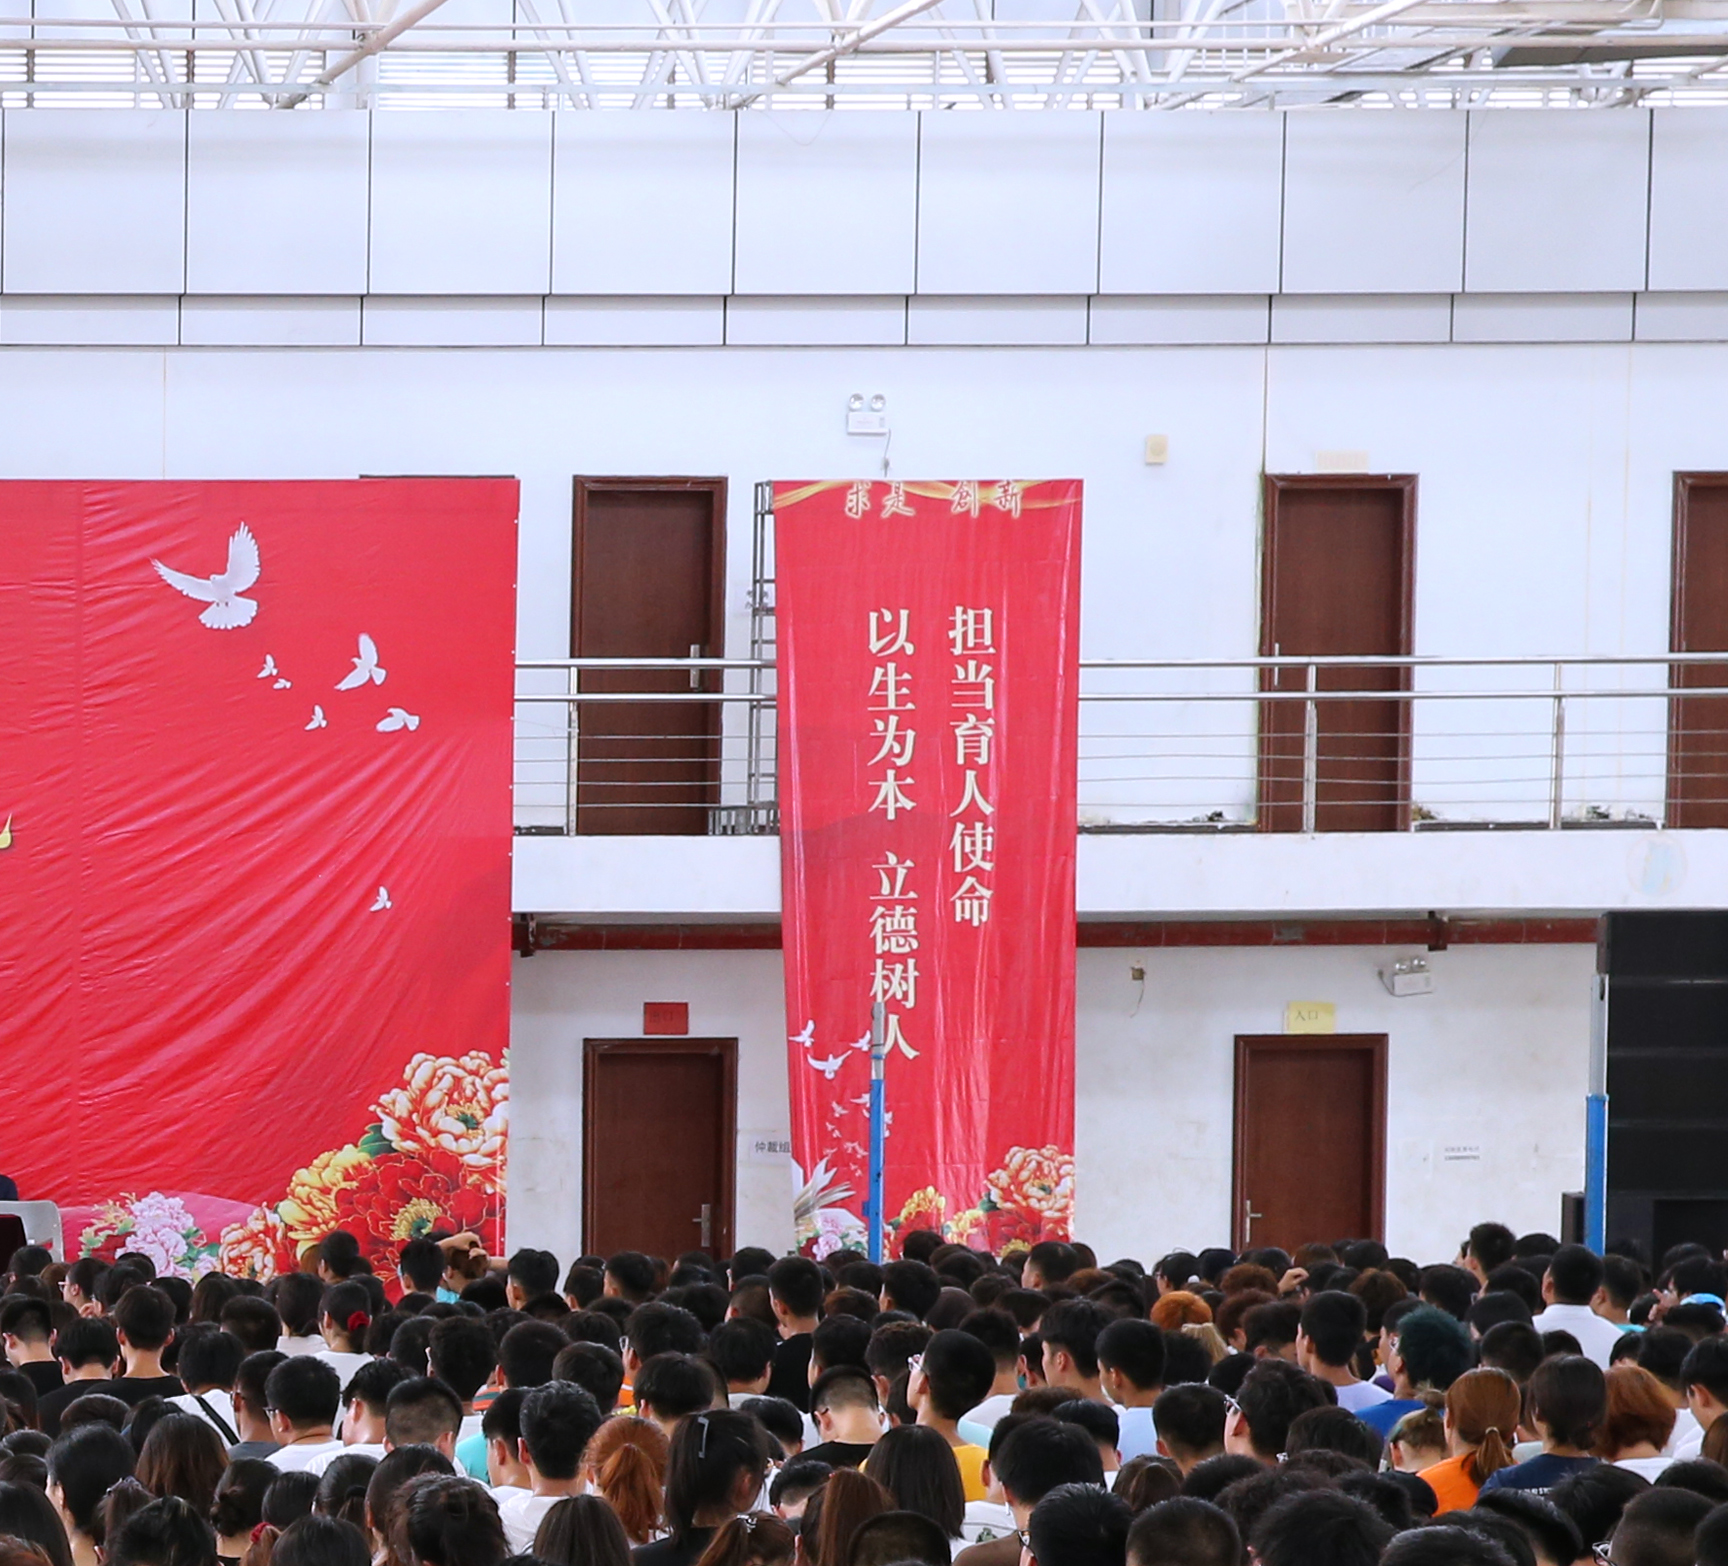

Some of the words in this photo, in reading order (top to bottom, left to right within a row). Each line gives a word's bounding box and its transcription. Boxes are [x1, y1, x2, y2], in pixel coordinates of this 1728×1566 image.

[868, 608, 918, 821] 以生为本
[947, 606, 997, 928] 担当育人使命
[869, 851, 921, 1061] 立德树人
[1294, 1010, 1319, 1022] 入口
